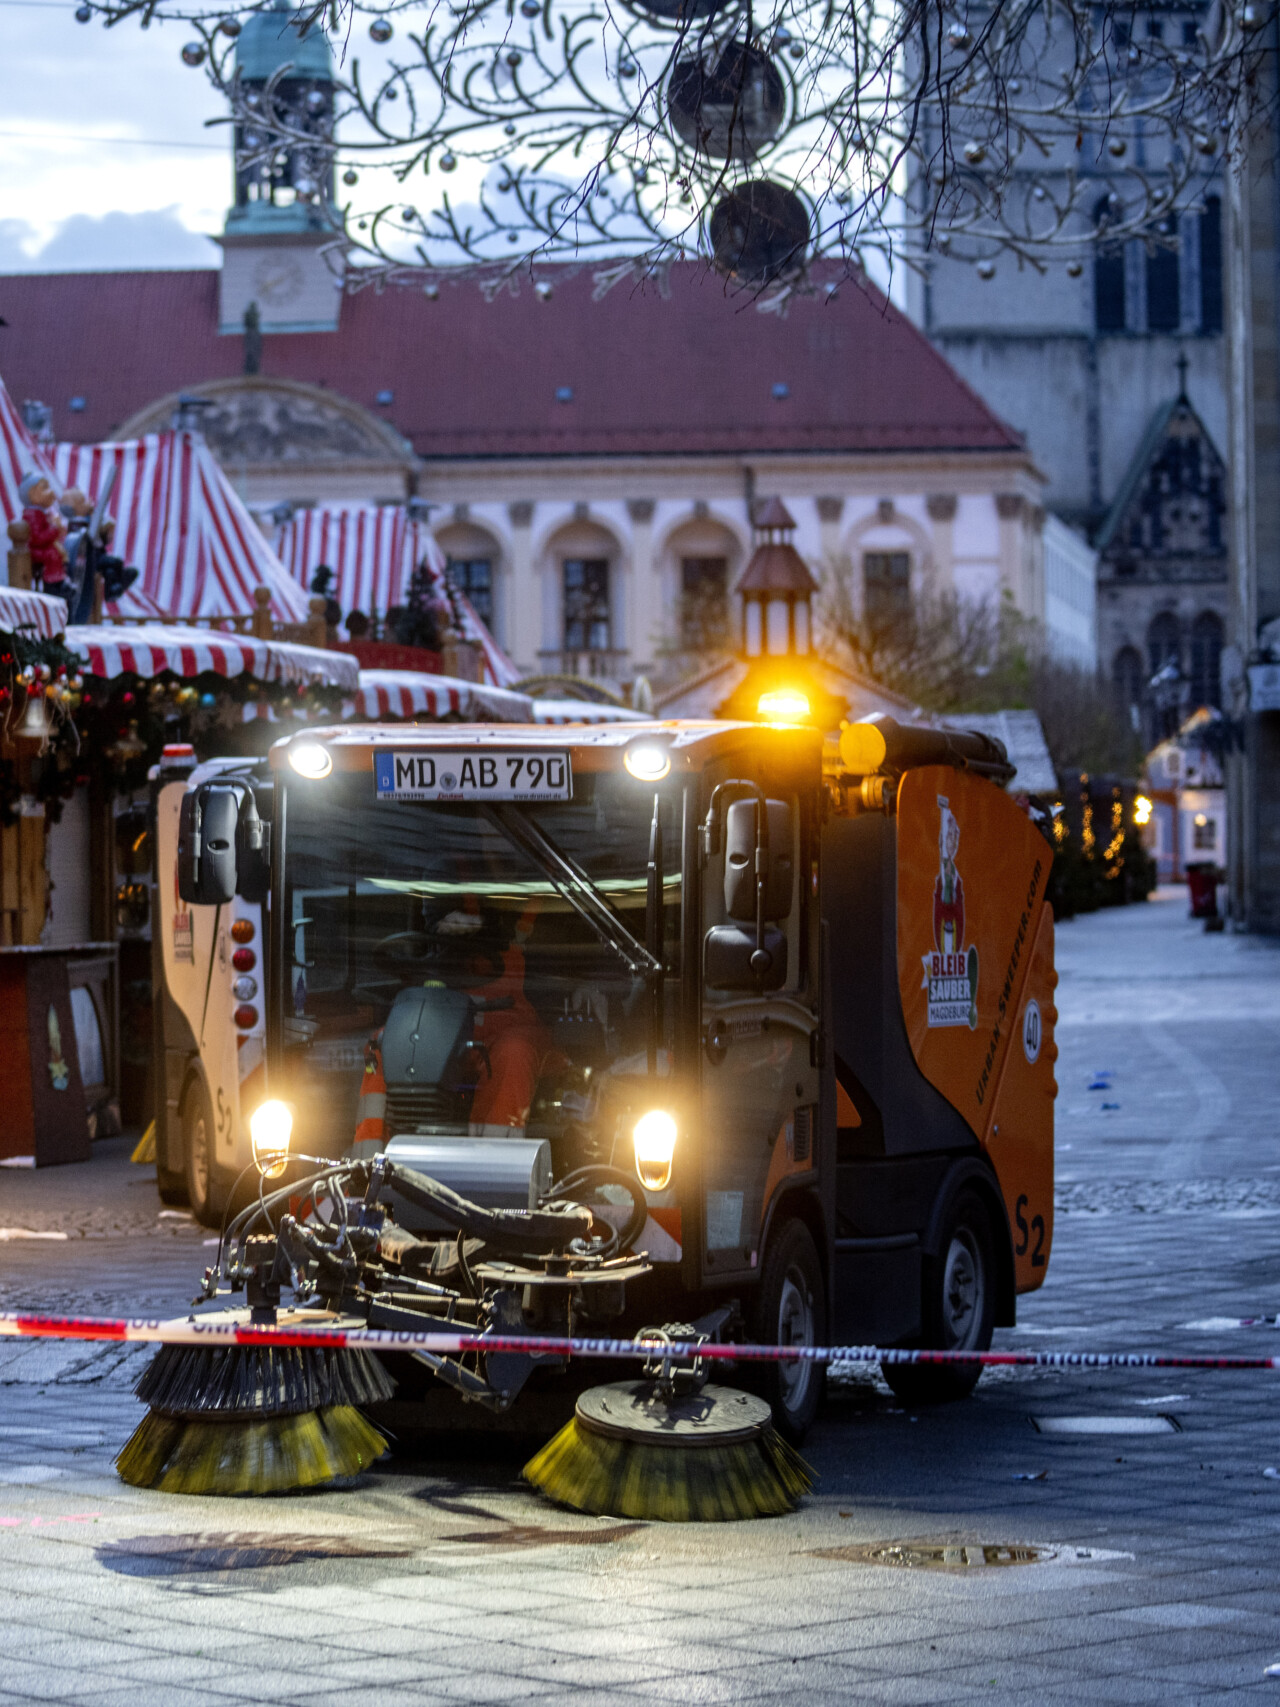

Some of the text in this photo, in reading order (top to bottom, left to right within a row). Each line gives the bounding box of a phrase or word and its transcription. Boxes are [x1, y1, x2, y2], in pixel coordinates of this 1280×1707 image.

[395, 758, 565, 788] MD AB 790
[932, 954, 966, 977] BLEIB
[930, 979, 971, 1001] SAUBER
[1026, 1012, 1038, 1051] 40
[1015, 1193, 1045, 1268] S2
